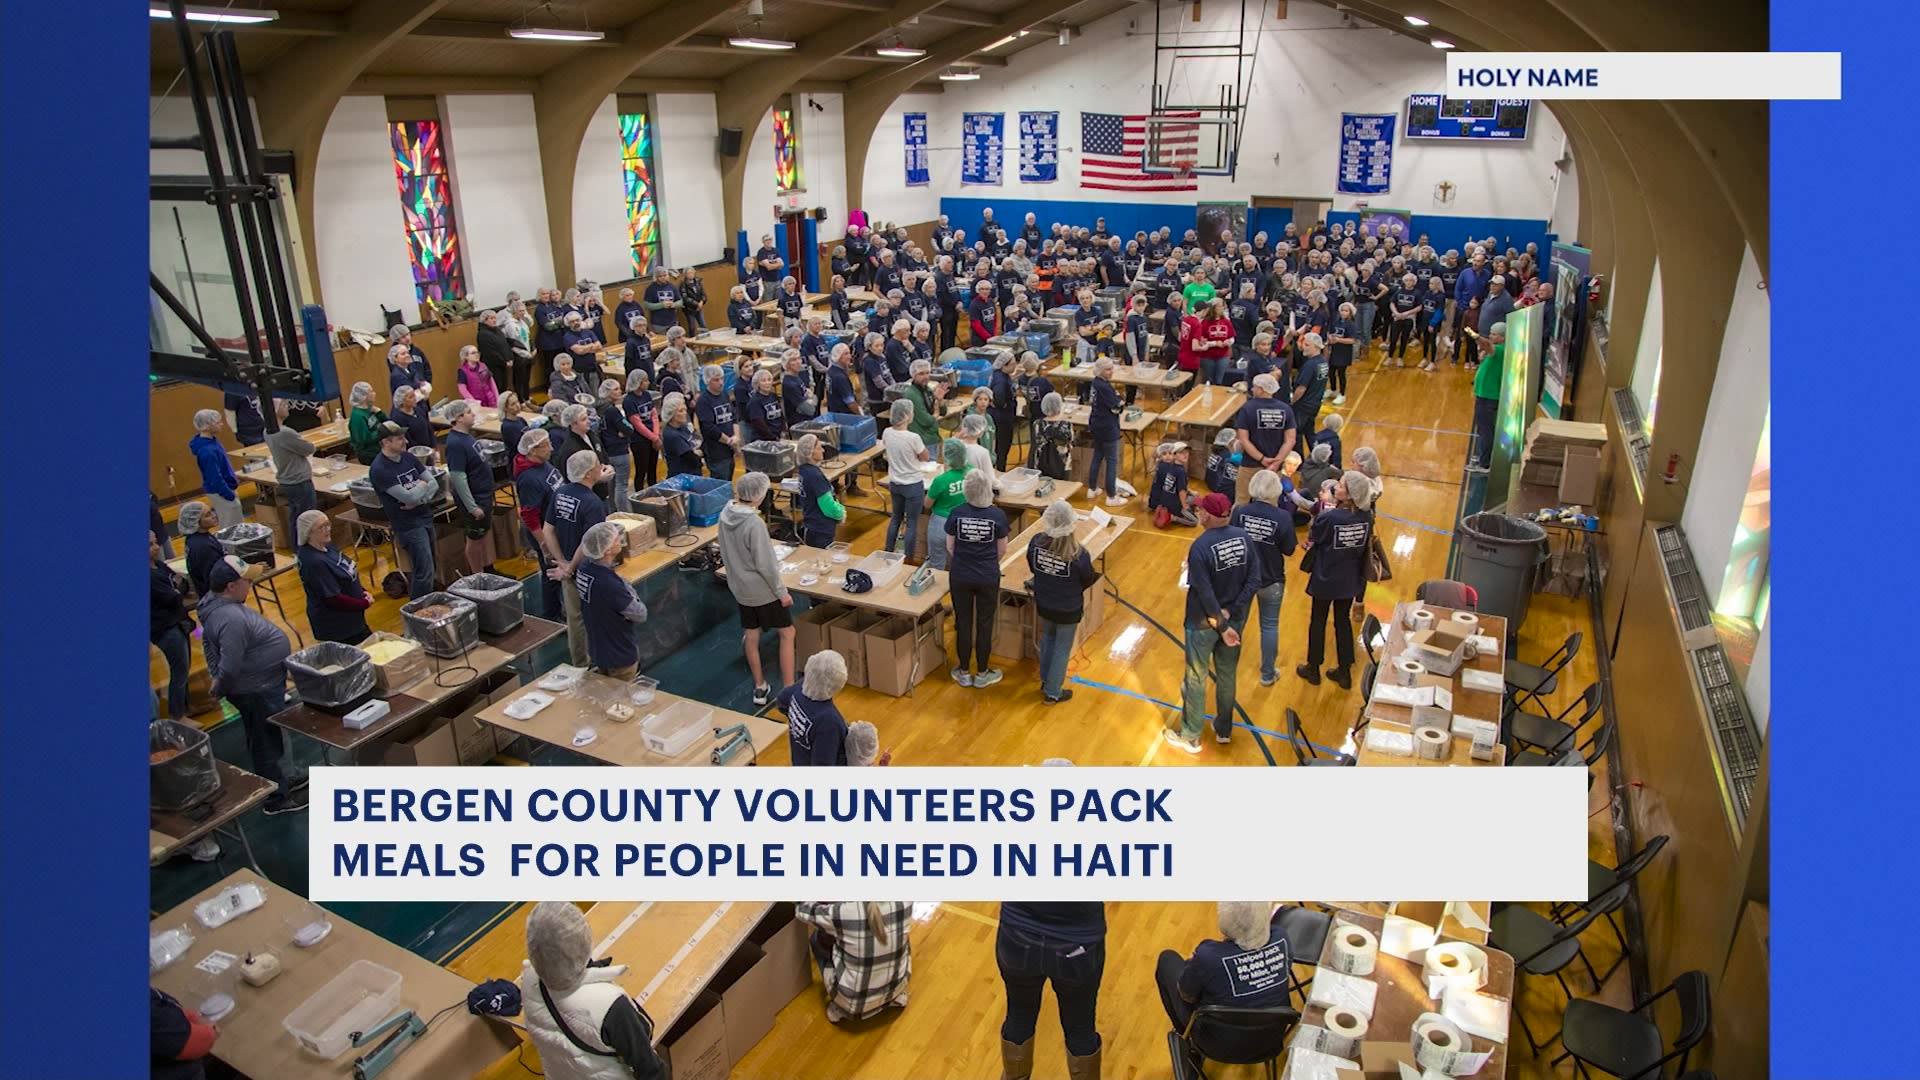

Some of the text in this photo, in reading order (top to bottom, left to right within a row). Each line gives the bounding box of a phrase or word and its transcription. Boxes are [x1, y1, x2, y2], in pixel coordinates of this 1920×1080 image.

[1411, 96, 1438, 106] HOME
[1498, 98, 1528, 106] GUEST
[1237, 951, 1264, 964] helped
[1264, 946, 1280, 958] pack
[1237, 960, 1265, 974] 50,000
